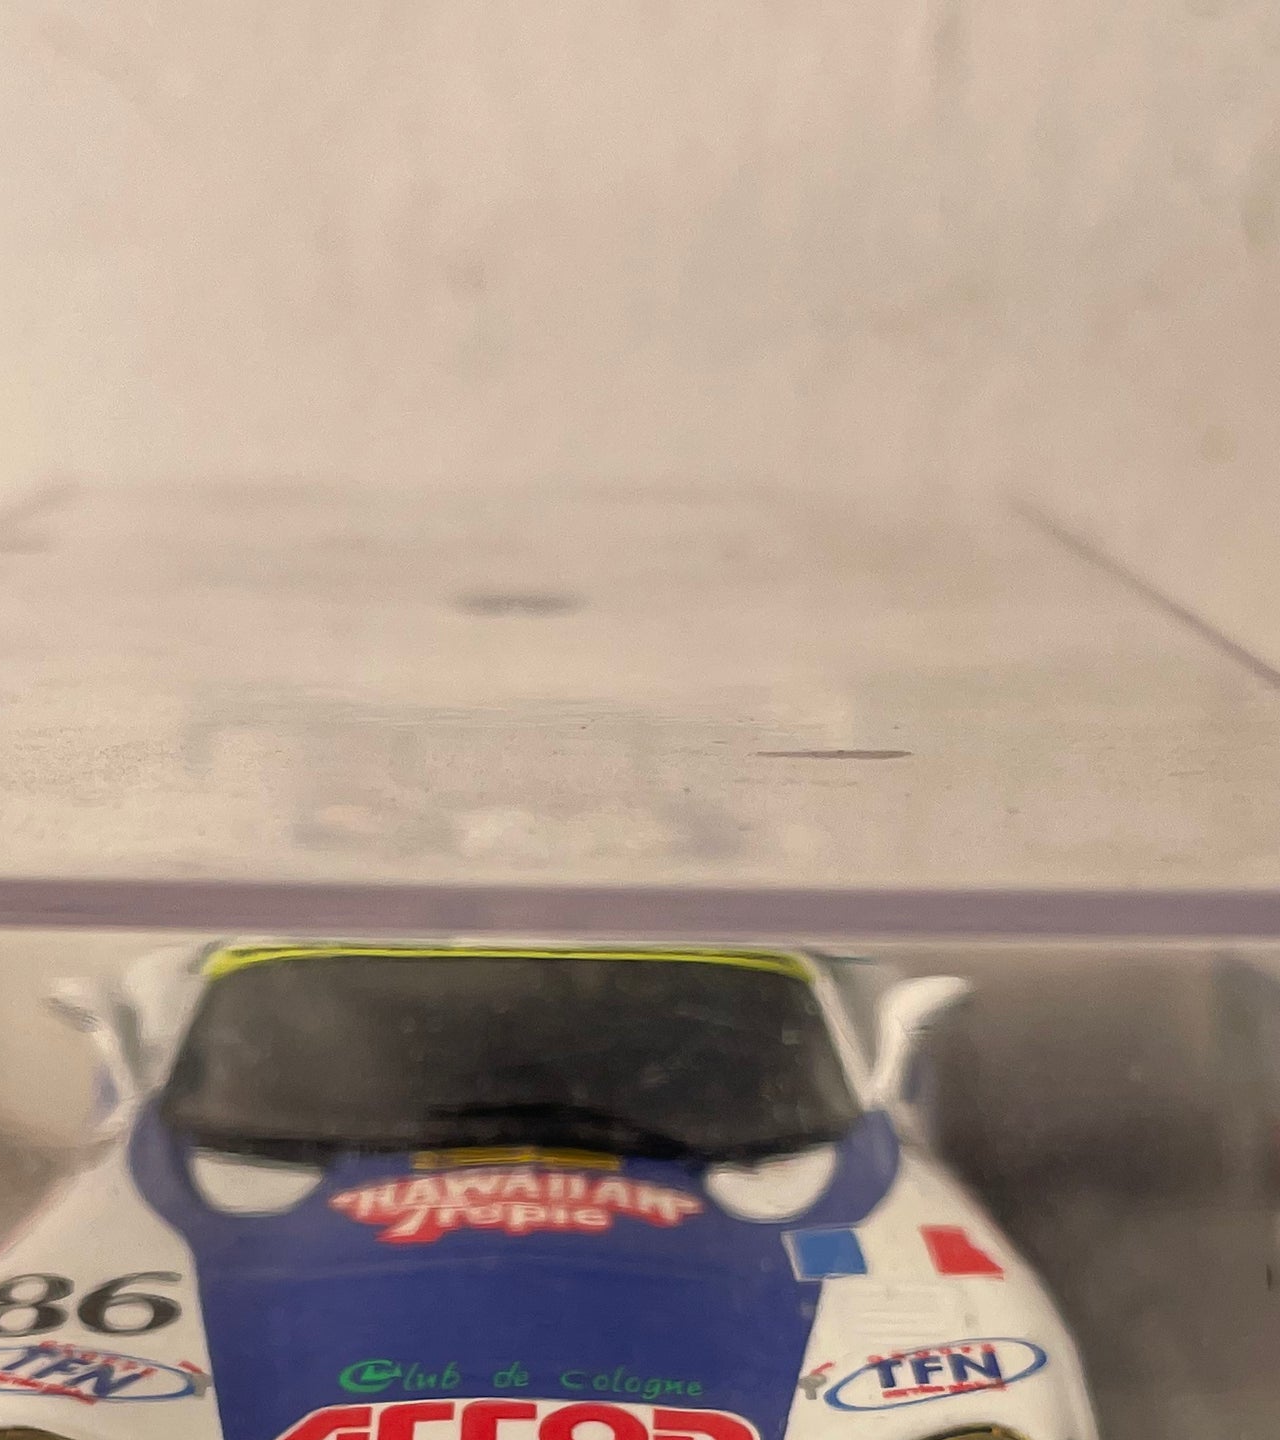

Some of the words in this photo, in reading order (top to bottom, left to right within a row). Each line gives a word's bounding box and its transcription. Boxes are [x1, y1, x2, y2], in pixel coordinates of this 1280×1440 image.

[1, 1346, 144, 1396] TFN
[338, 1358, 458, 1393] Club
[492, 1360, 530, 1390] de
[870, 1348, 1004, 1388] TFN
